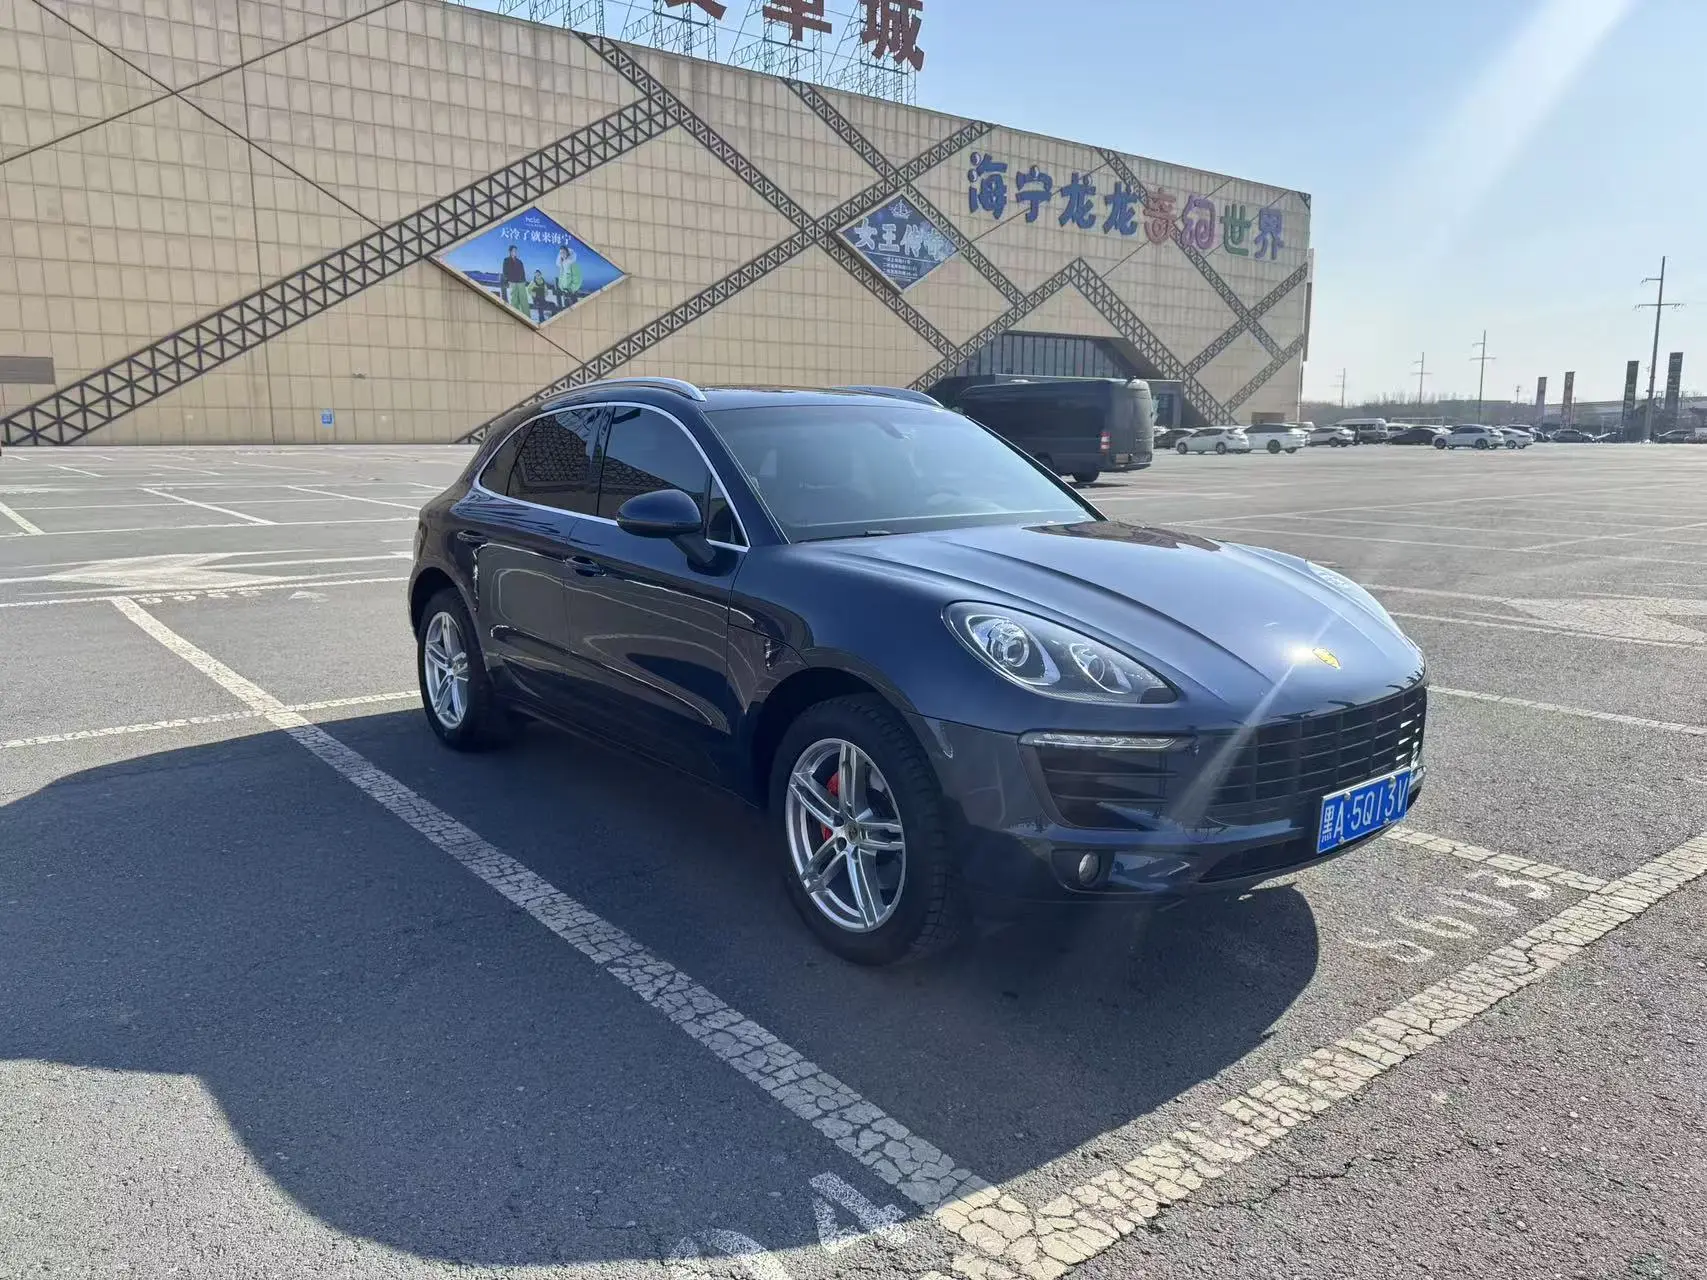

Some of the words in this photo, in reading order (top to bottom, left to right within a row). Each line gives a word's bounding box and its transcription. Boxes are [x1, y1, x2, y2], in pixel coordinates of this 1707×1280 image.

[500, 227, 572, 246] 天冷了就来海宁
